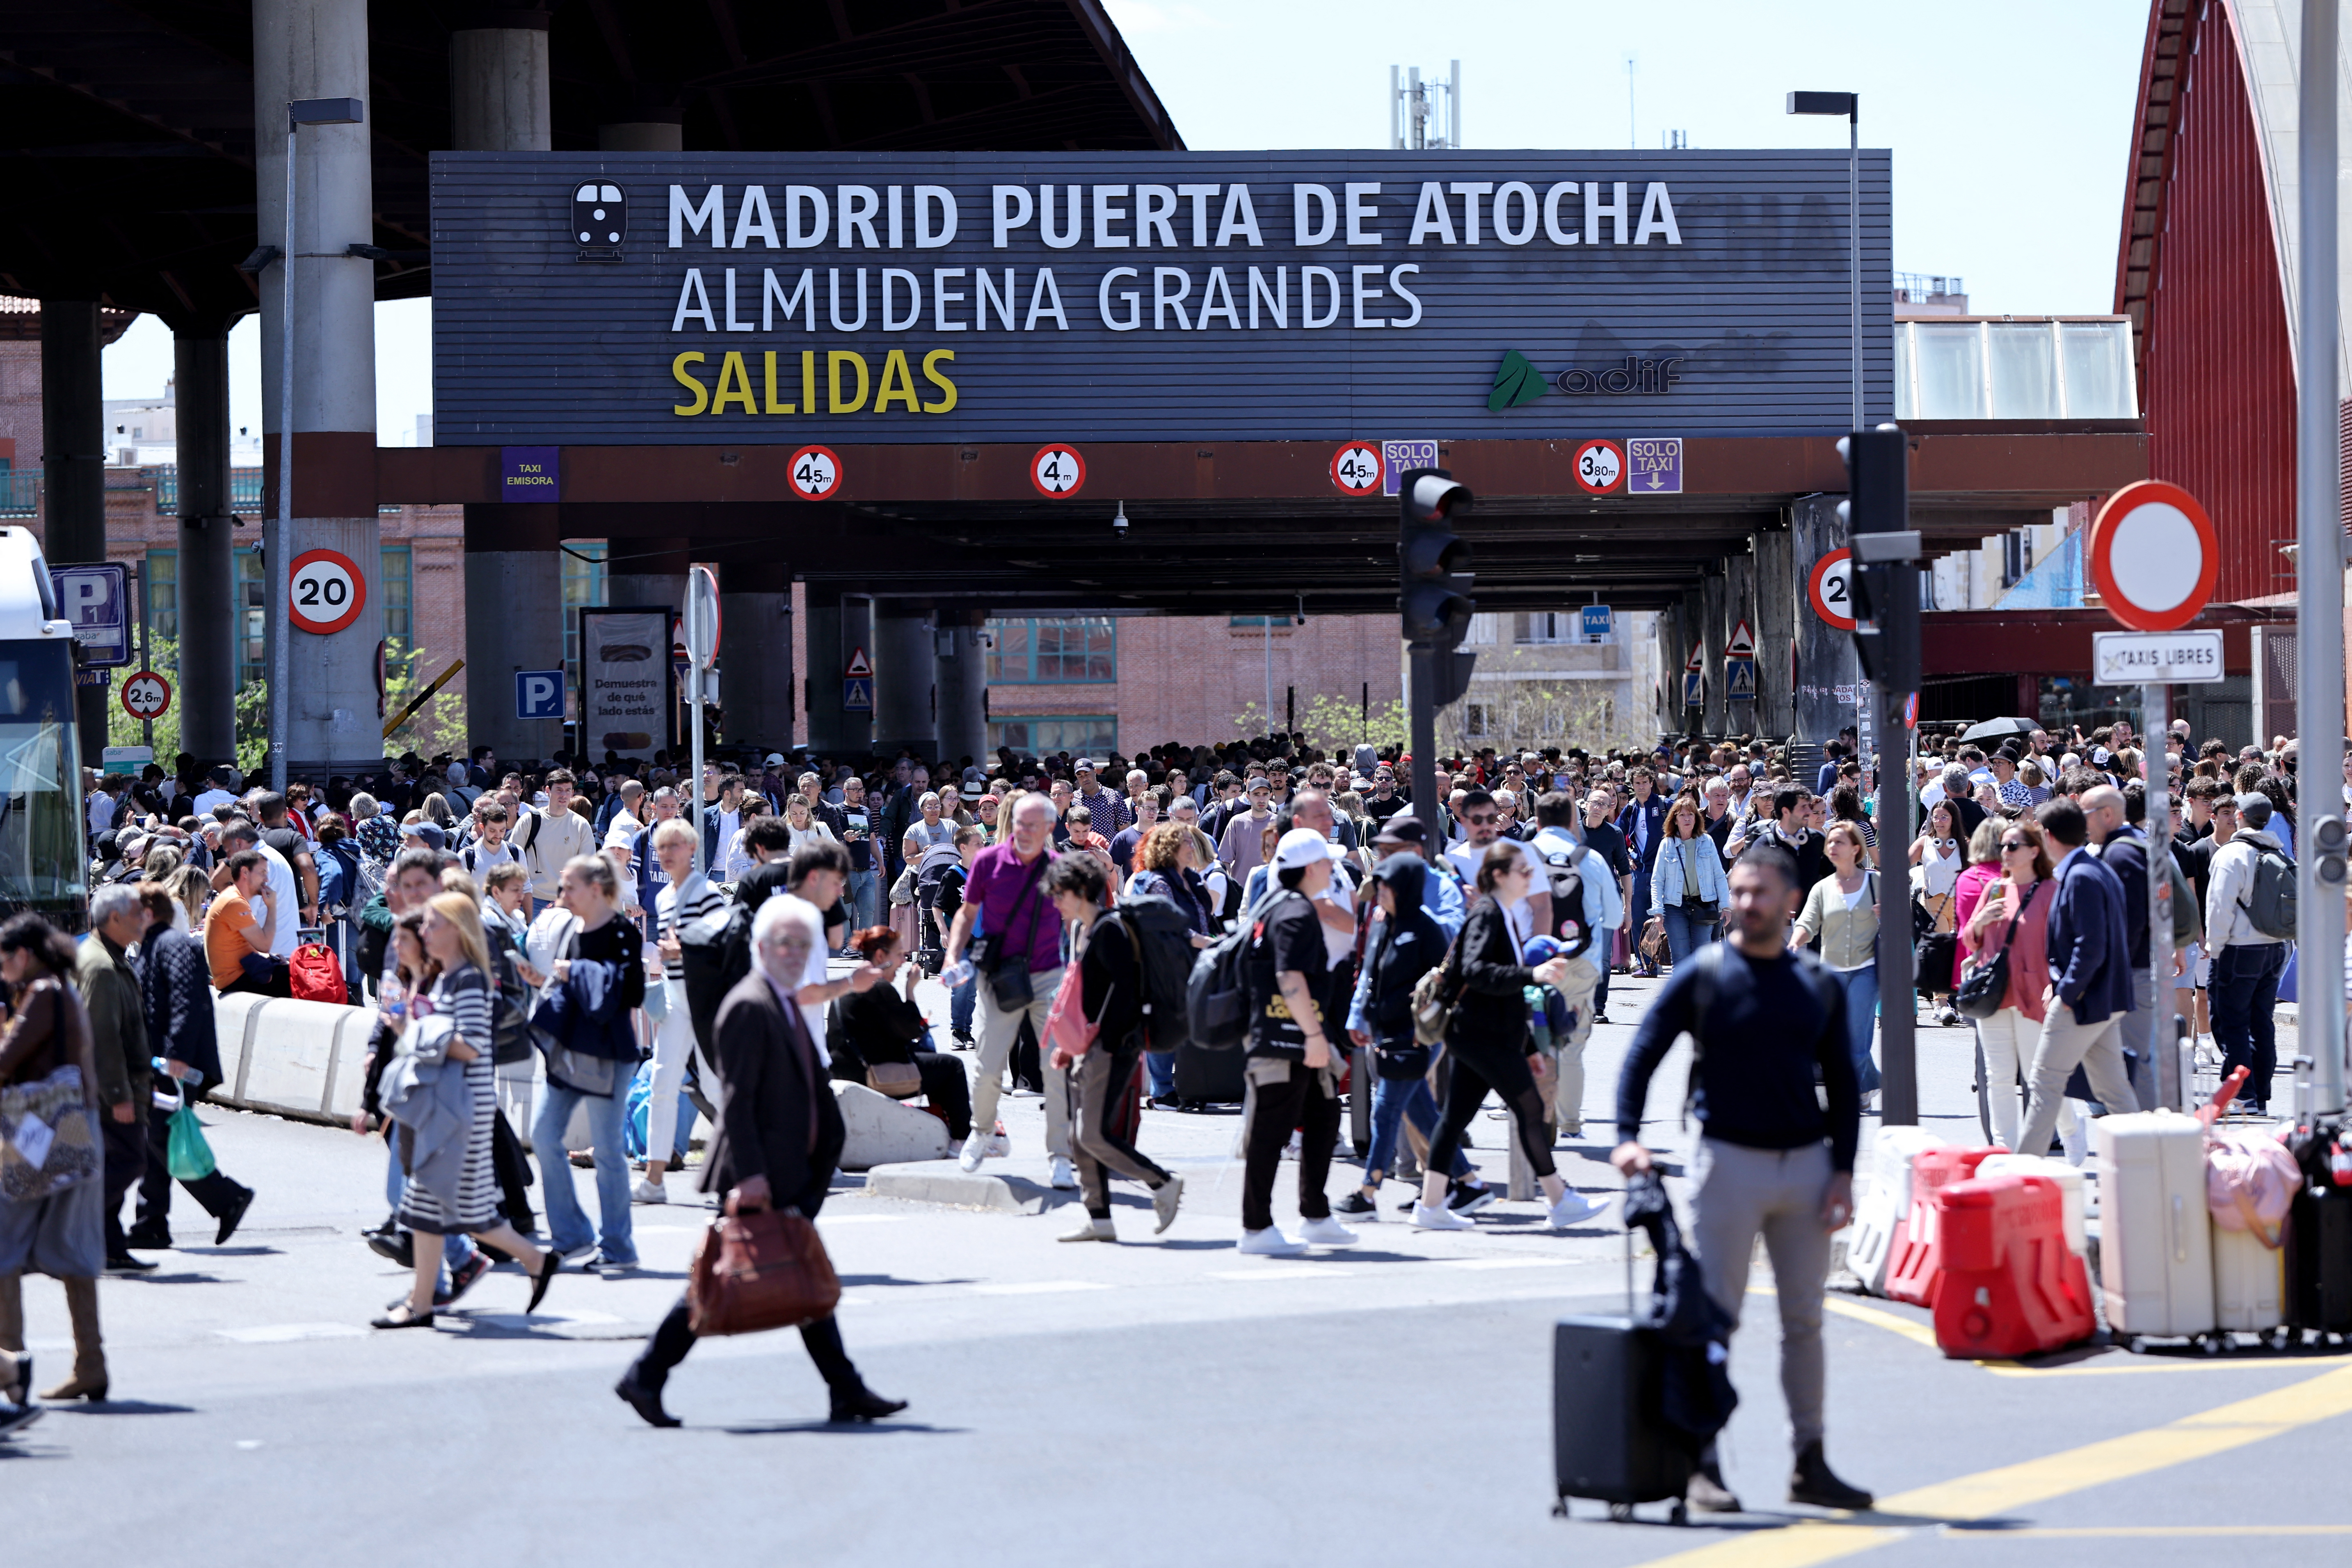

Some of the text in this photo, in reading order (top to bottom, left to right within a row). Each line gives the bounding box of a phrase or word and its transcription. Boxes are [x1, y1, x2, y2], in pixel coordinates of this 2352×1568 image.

[669, 185, 958, 248] MADRID
[993, 183, 1264, 249] PUERTA
[1294, 183, 1382, 246] DE
[1409, 181, 1682, 245] ATOCHA
[672, 263, 1422, 331] ALMUDENA GRANDES
[673, 349, 958, 416] SALIDAS
[1557, 356, 1684, 394] adif
[1387, 445, 1433, 459] SOLO
[1632, 442, 1678, 457] SOLO
[519, 464, 541, 473] TAXI
[1392, 459, 1428, 473] TAXI
[1637, 457, 1673, 471] TAXI
[507, 477, 554, 485] EMISORA
[299, 578, 346, 606] 20
[1827, 576, 1847, 602] 2
[63, 574, 107, 624] P
[89, 606, 98, 623] 1
[1584, 615, 1609, 625] TAXI
[75, 631, 96, 640] saba
[2121, 648, 2214, 665] TAXIS LIBRES
[595, 679, 657, 688] Demuestra
[130, 688, 161, 704] 2,6m
[526, 677, 554, 713] P
[607, 692, 646, 704] de qué
[599, 705, 655, 715] lado estás
